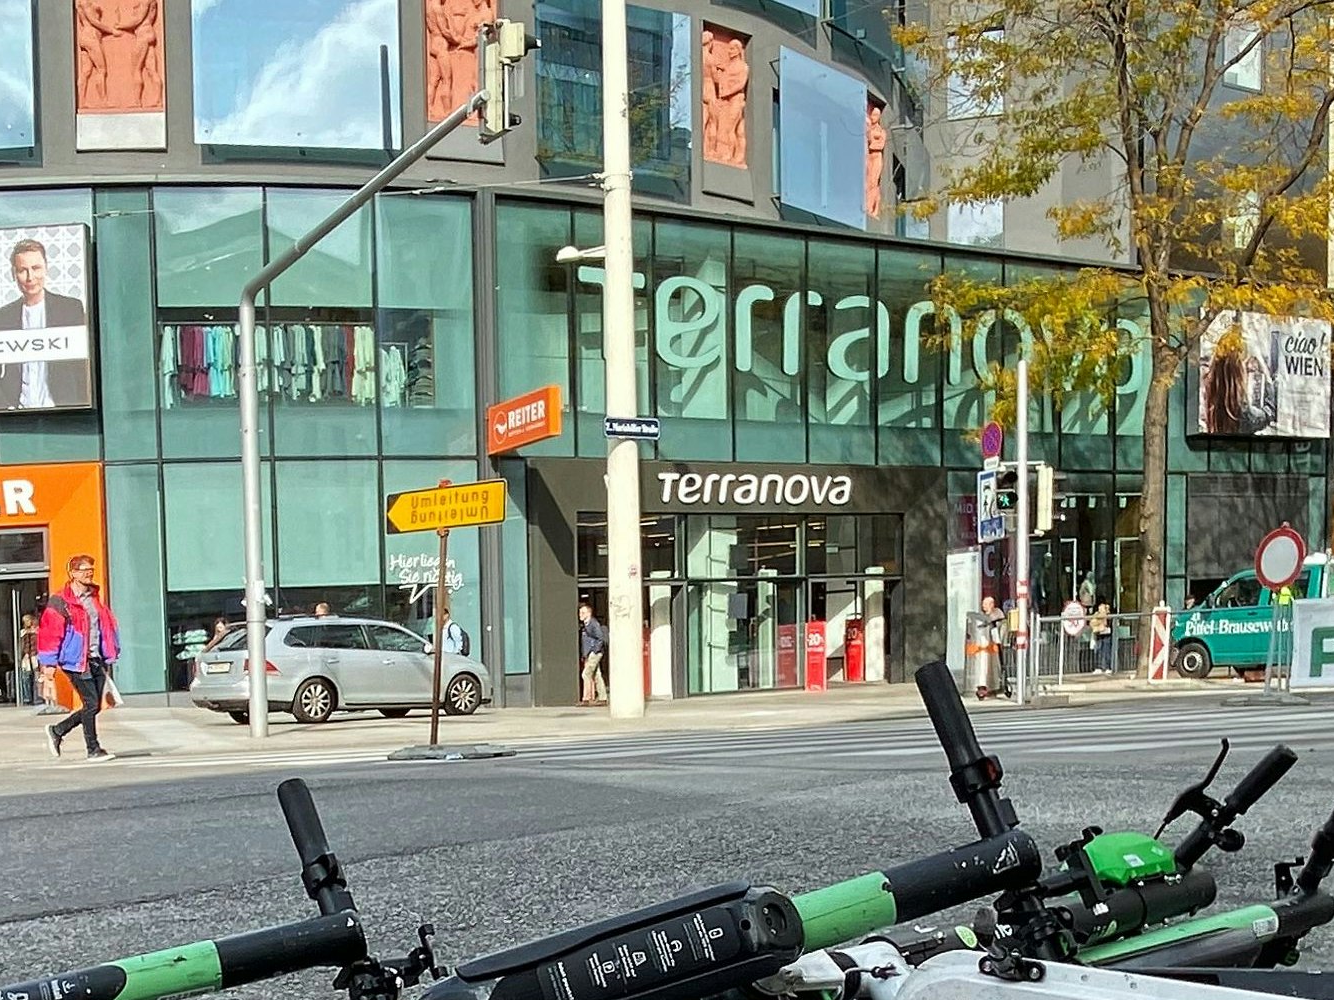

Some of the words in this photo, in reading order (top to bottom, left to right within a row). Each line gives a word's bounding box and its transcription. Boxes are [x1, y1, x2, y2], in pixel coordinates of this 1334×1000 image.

[1285, 331, 1327, 354] ciao!
[1285, 355, 1324, 377] WIEN
[507, 400, 546, 429] REITER
[411, 489, 489, 509] Umleitung
[657, 471, 853, 506] Terranova
[410, 505, 489, 525] Umleitung
[389, 552, 420, 570] Hier
